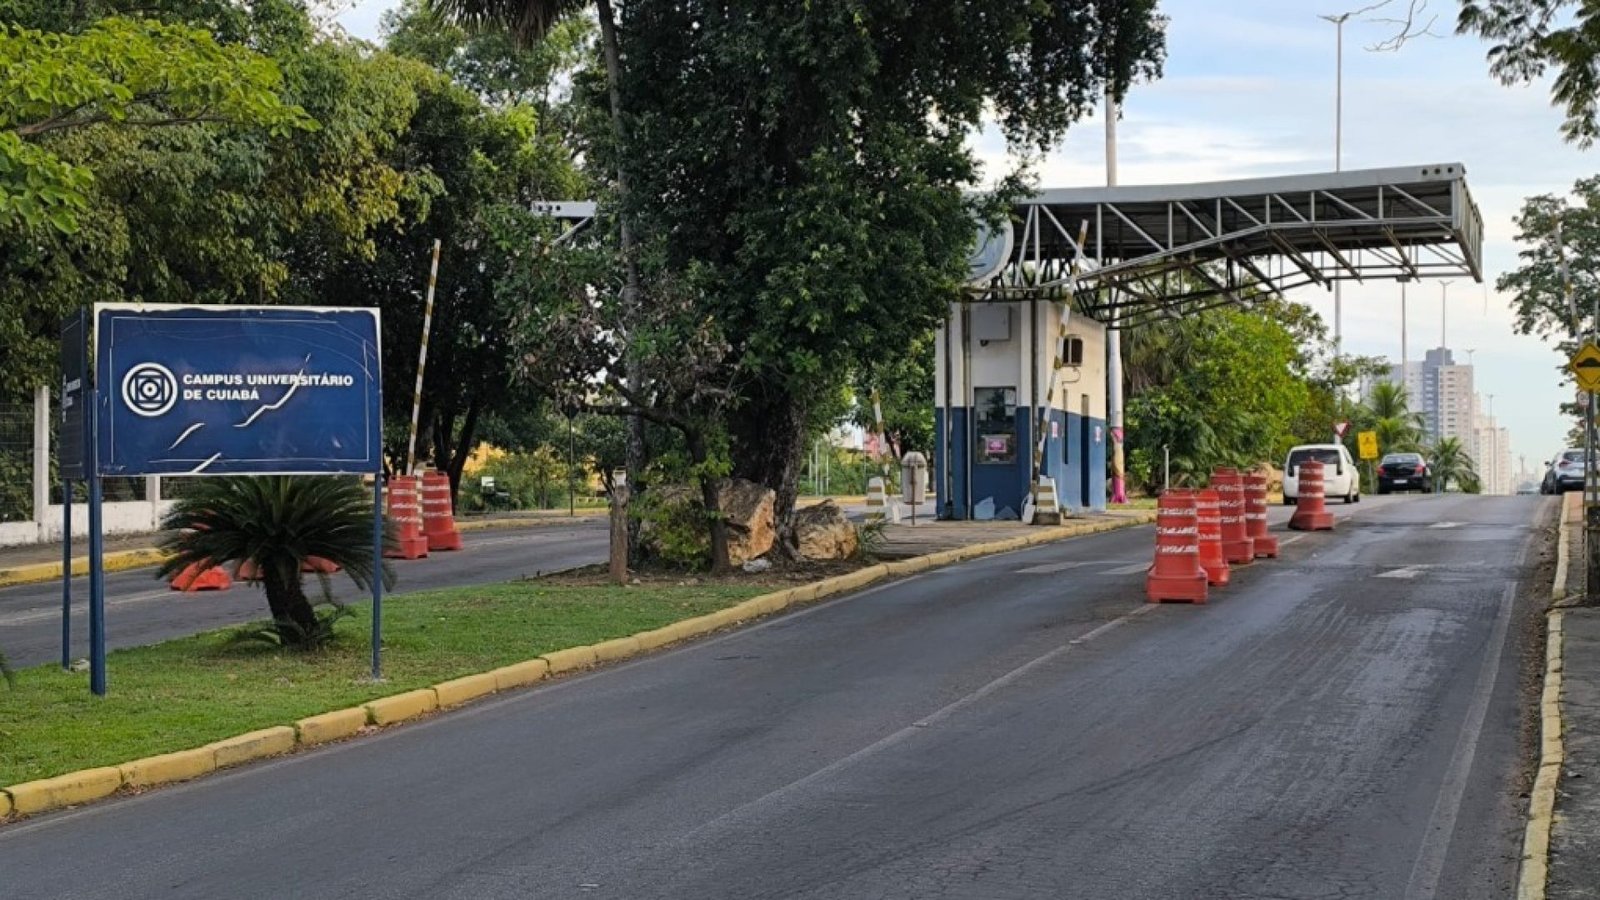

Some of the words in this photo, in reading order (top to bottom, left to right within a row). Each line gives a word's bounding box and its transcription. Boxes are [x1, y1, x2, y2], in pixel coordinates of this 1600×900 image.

[183, 374, 243, 385] CAMPUS
[247, 372, 353, 386] UNIVERSITÁRIO
[183, 389, 202, 400] DE
[206, 387, 259, 400] CUIABÁ
